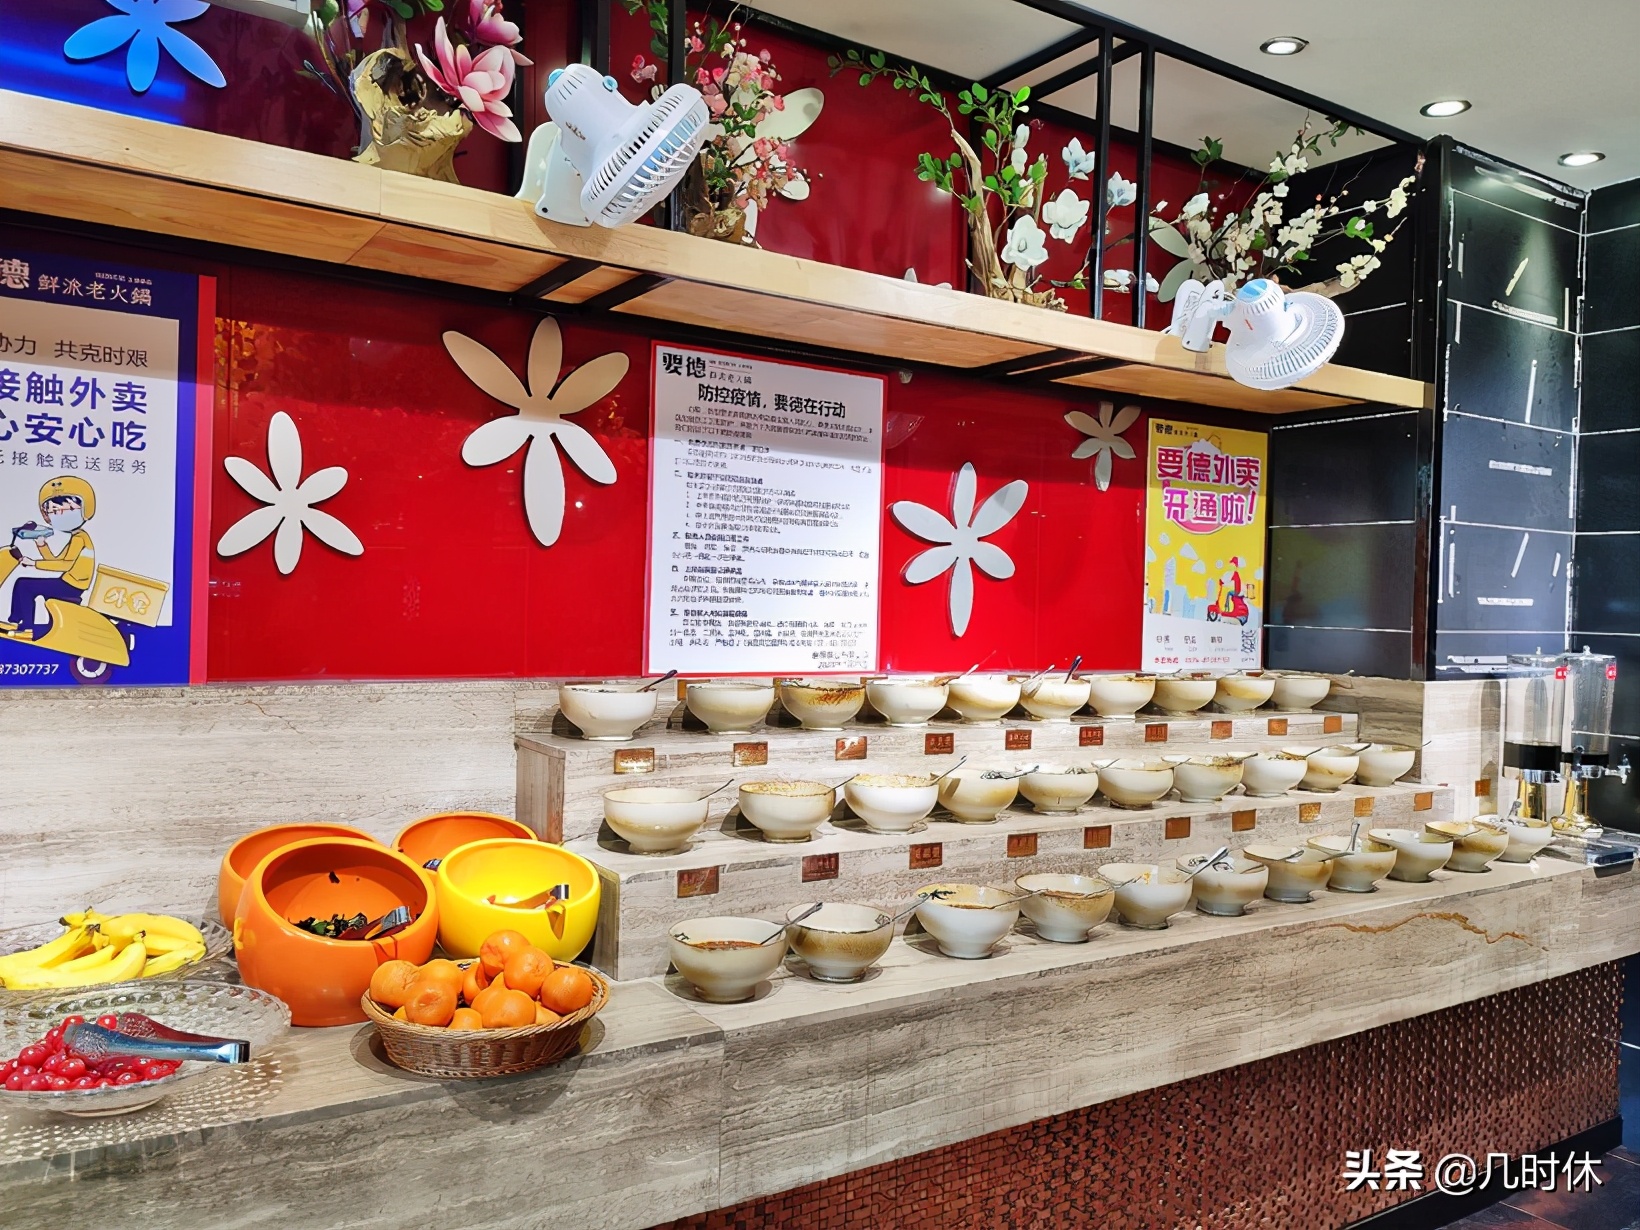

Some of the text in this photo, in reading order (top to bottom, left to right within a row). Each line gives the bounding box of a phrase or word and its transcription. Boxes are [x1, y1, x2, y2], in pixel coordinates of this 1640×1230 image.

[54, 340, 148, 367] 共克时艰
[1157, 446, 1260, 487] 要德外卖
